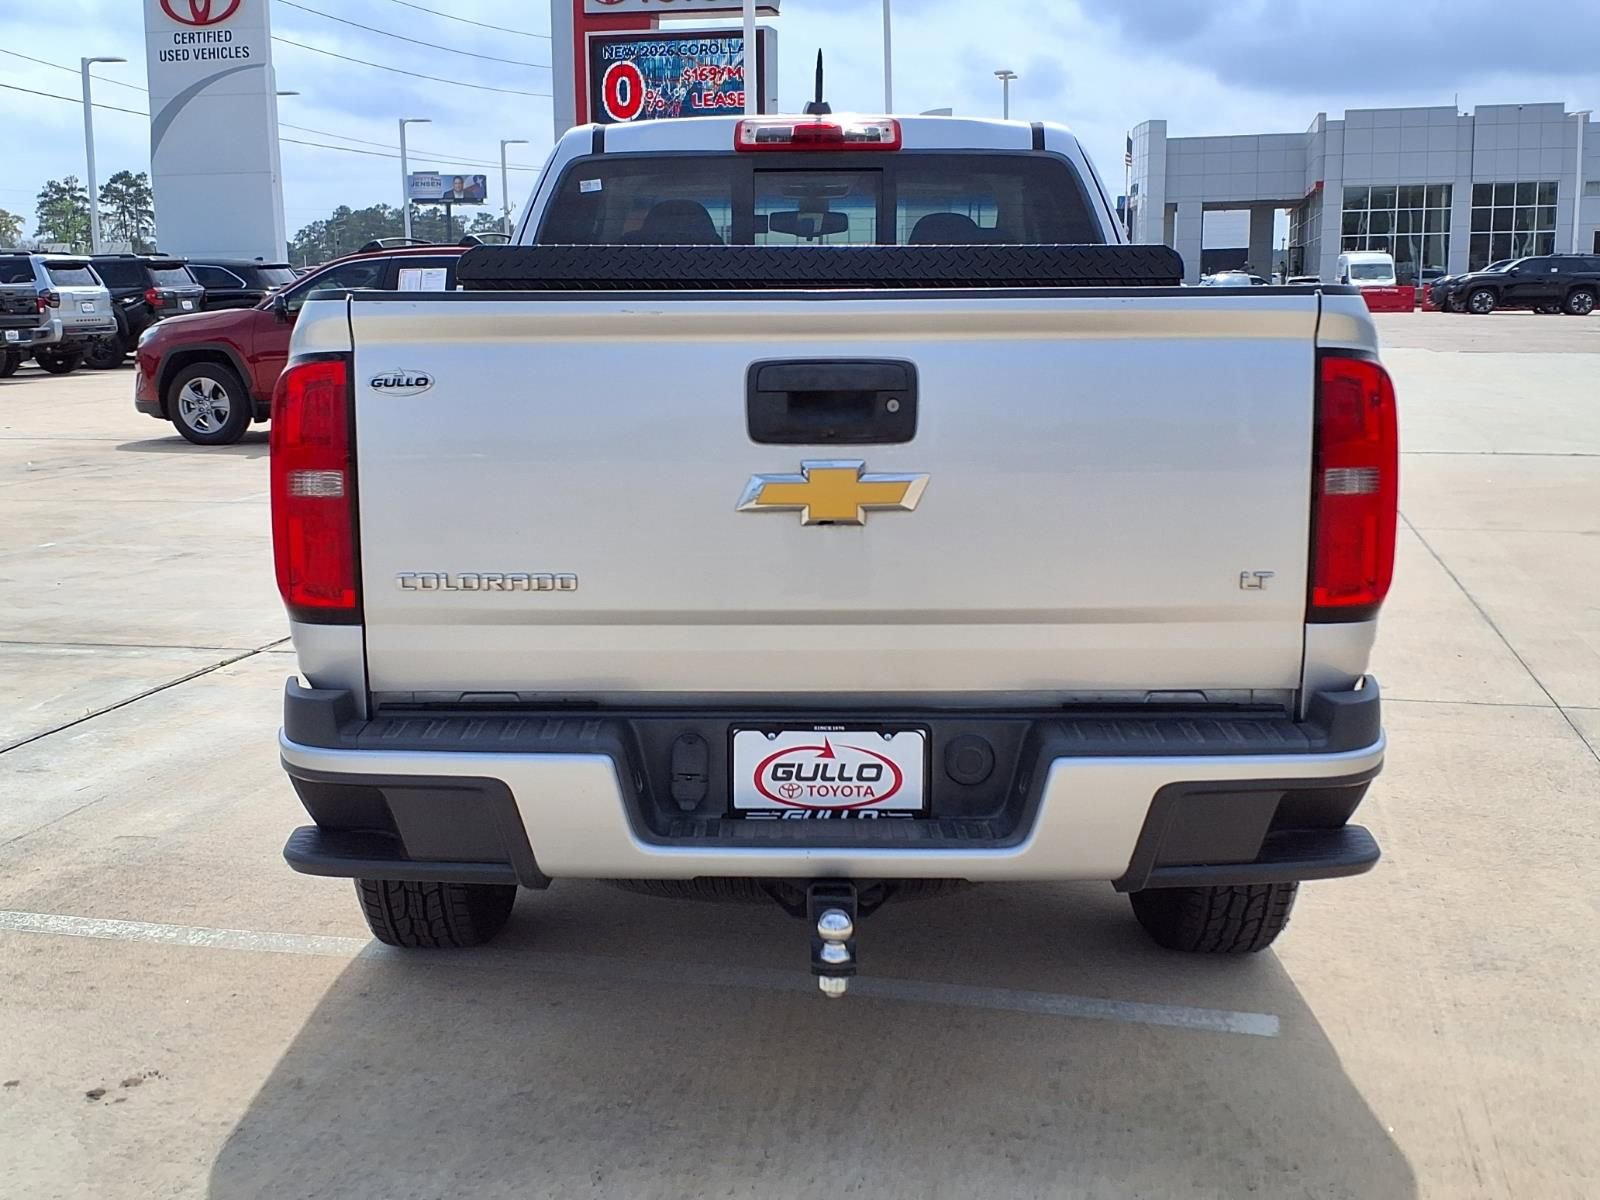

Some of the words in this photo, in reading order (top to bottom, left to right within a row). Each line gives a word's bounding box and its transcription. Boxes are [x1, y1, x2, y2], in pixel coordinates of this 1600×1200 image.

[173, 31, 232, 44] CERTIFIED
[160, 49, 190, 62] USED
[193, 46, 250, 60] VEHICLES
[602, 45, 636, 59] NEW
[640, 44, 674, 58] 2026
[683, 66, 744, 82] $169/M
[691, 92, 744, 108] LEASE
[371, 377, 429, 388] GULLO
[396, 572, 578, 592] COLORADO
[1239, 571, 1274, 590] LT
[771, 763, 883, 782] GULLO
[807, 785, 875, 798] TOYOTA
